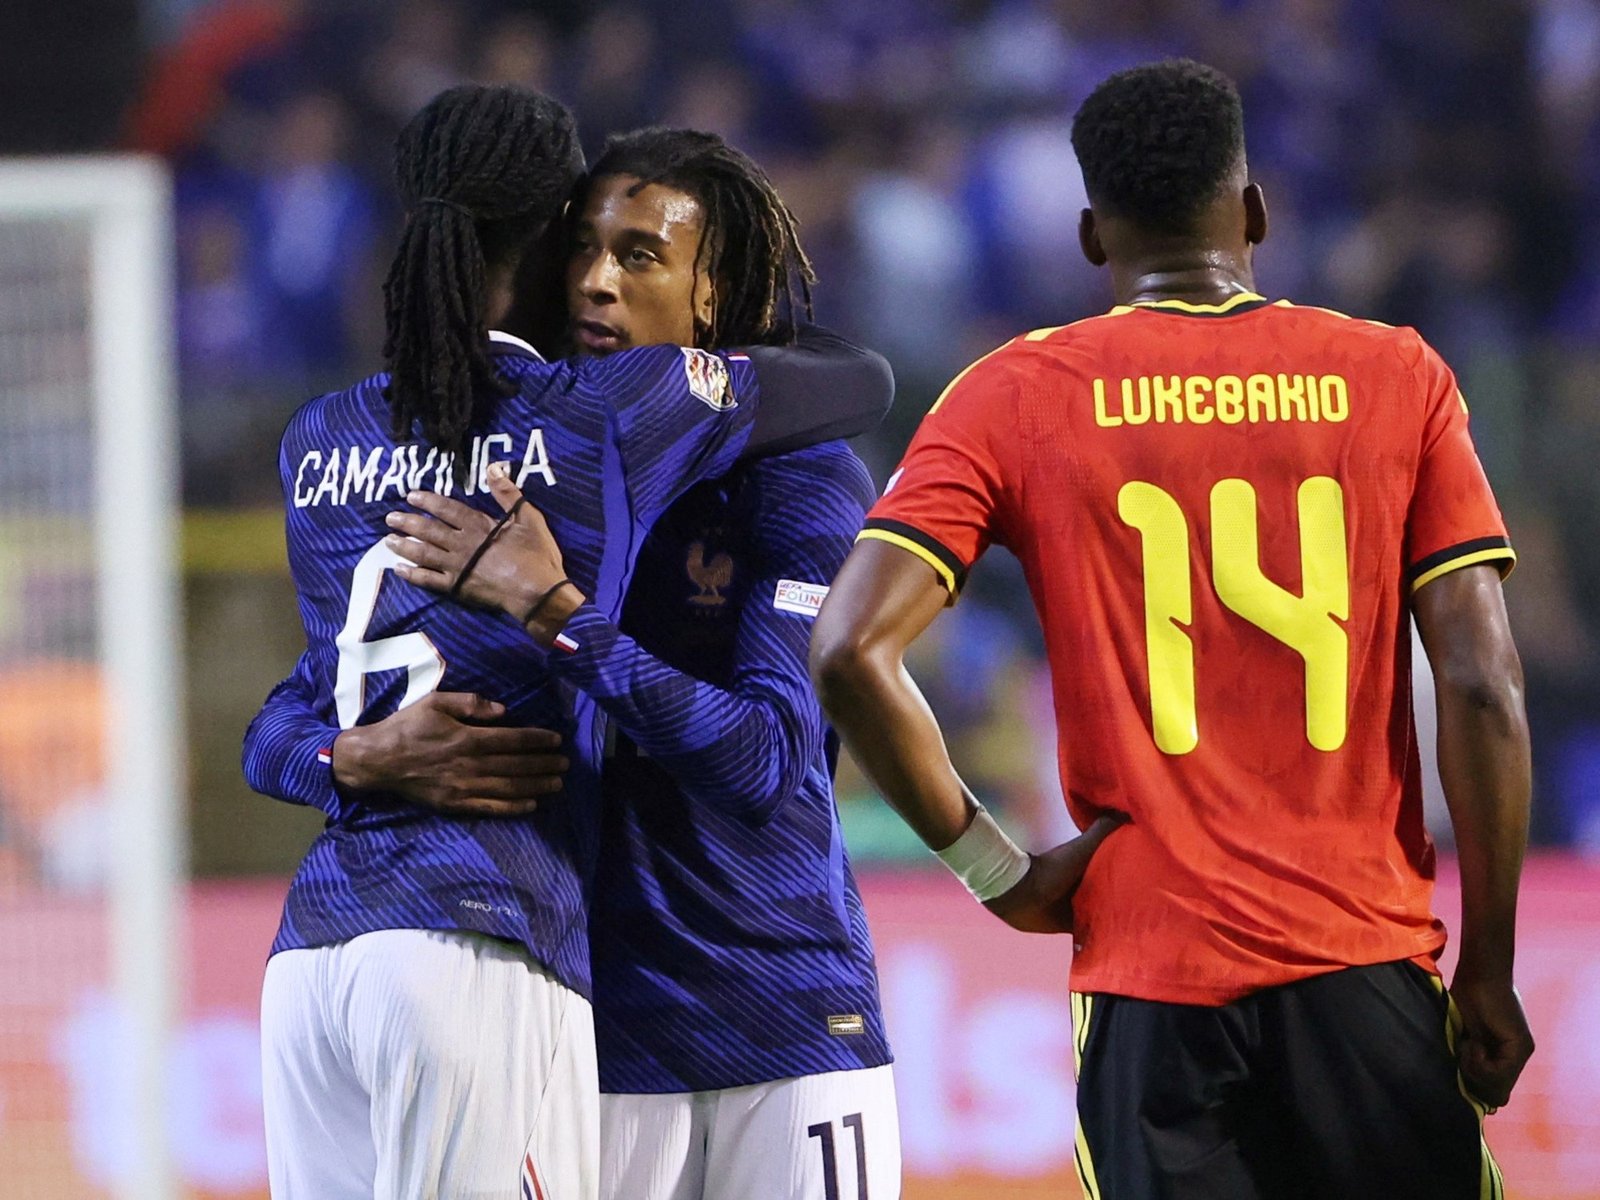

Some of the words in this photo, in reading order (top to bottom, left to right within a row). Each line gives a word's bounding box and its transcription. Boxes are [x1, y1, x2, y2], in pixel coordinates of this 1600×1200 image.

[1093, 373, 1349, 427] LUKEBAKIO
[334, 533, 447, 731] 6
[1117, 475, 1349, 755] 14
[808, 1112, 869, 1200] 11
